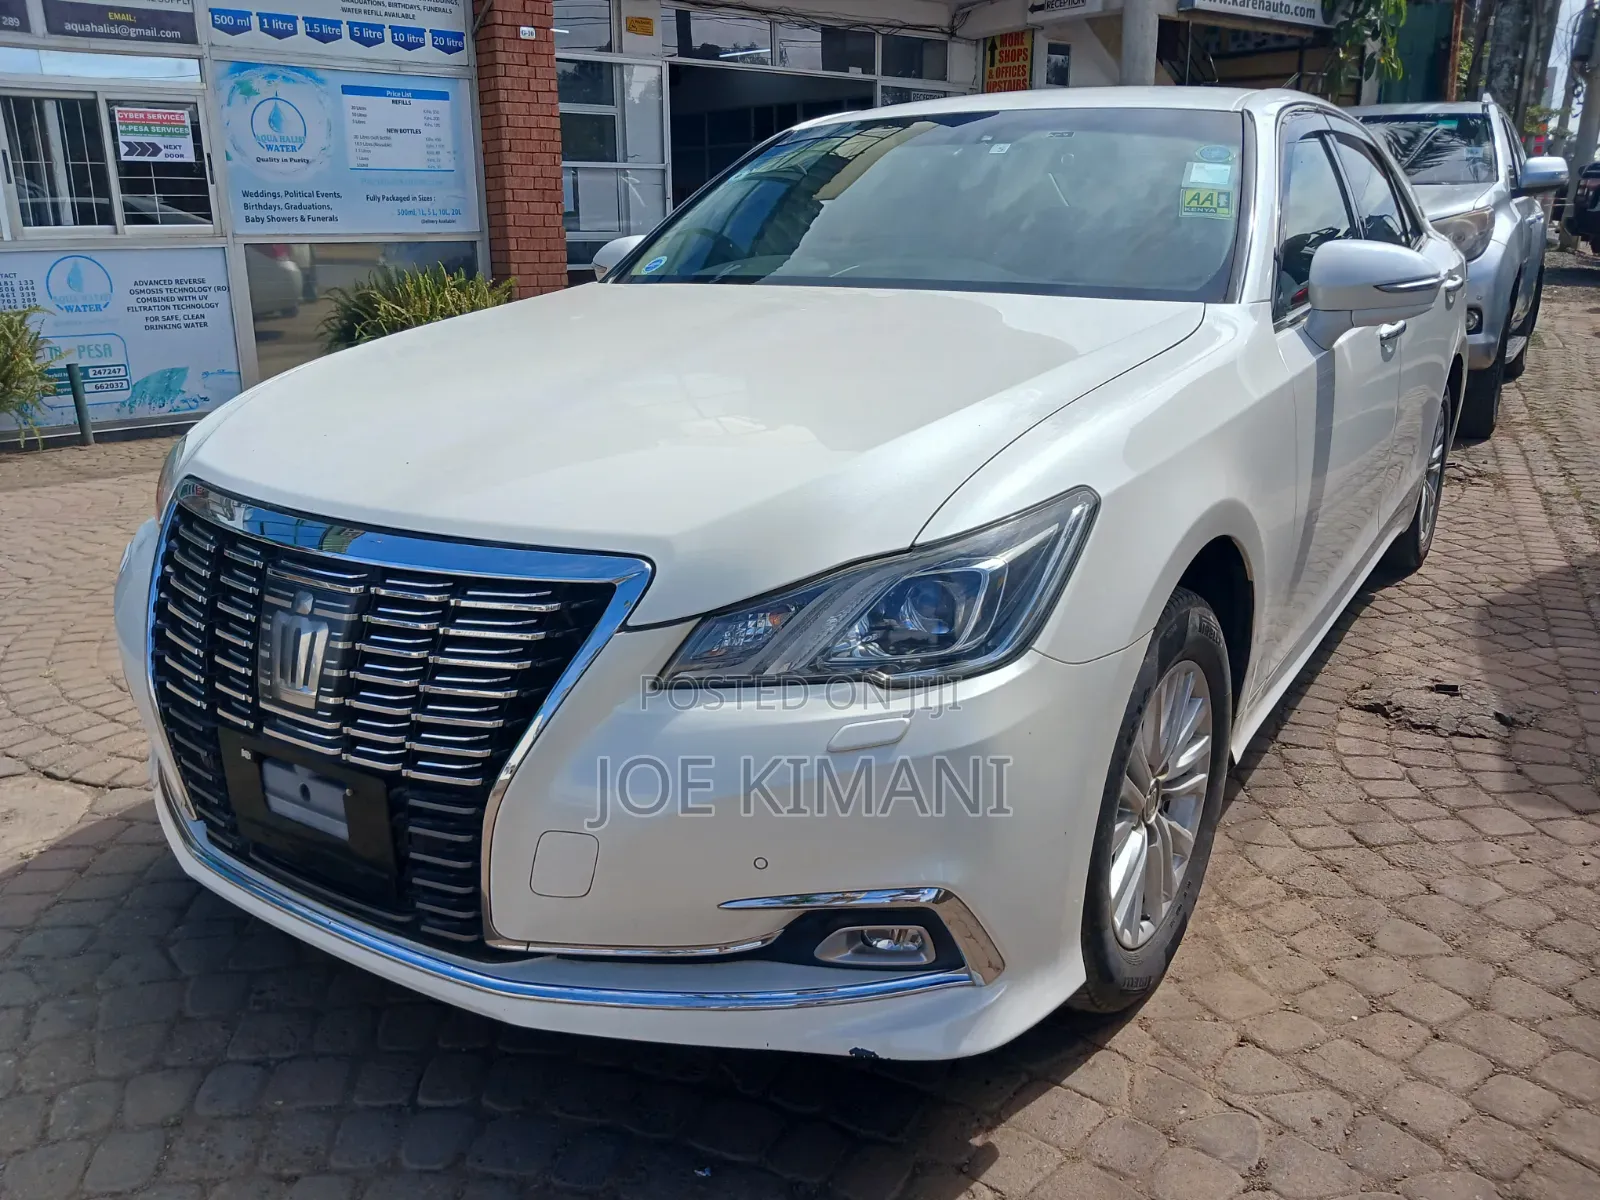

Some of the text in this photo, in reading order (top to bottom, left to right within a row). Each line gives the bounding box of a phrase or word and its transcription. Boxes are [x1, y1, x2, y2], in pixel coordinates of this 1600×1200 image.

[388, 1, 422, 11] BIRTHDAYS,
[423, 5, 452, 14] FUNERALS
[363, 9, 383, 17] REFILL
[384, 11, 416, 20] AVAILABLE
[2, 16, 20, 27] 289
[214, 14, 249, 27] 500 ml
[263, 18, 294, 31] 1 litre
[64, 22, 181, 39] aquahalisi@gmail.com
[305, 23, 341, 36] 1.5 litre
[354, 27, 382, 39] 5 litre
[393, 32, 425, 44] 10 litre
[433, 36, 463, 48] 20 litre
[999, 32, 1025, 48] MORE
[998, 48, 1028, 63] SHOPS
[988, 65, 1027, 79] & OFFICES
[986, 79, 1027, 93] UPSTAIRS
[386, 90, 401, 98] Price
[146, 113, 185, 121] SERVICES
[151, 126, 189, 134] SERVICES
[256, 134, 278, 143] AQUA
[265, 144, 298, 153] WATER
[241, 189, 343, 200] Weddings, Political Events,
[366, 194, 380, 203] Fully
[381, 194, 411, 203] Packaged
[1186, 192, 1214, 206] AA
[243, 202, 333, 212] Birthdays, Graduations,
[451, 208, 462, 216] 20L
[245, 214, 338, 224] Baby Showers & Funerals
[133, 279, 173, 287] ADVANCED
[129, 285, 230, 295] OSMOSIS TECHNOLOGY (RO)
[136, 295, 176, 304] COMBINED
[176, 294, 197, 302] WITH
[64, 304, 103, 313] WATER
[127, 302, 219, 313] FILTRATION TECHNOLOGY
[161, 314, 181, 322] SAFE,
[182, 313, 205, 321] CLEAN
[144, 321, 209, 331] DRINKING WATER
[77, 343, 113, 359] PESA
[93, 367, 122, 376] 247247
[94, 381, 124, 390] 662032
